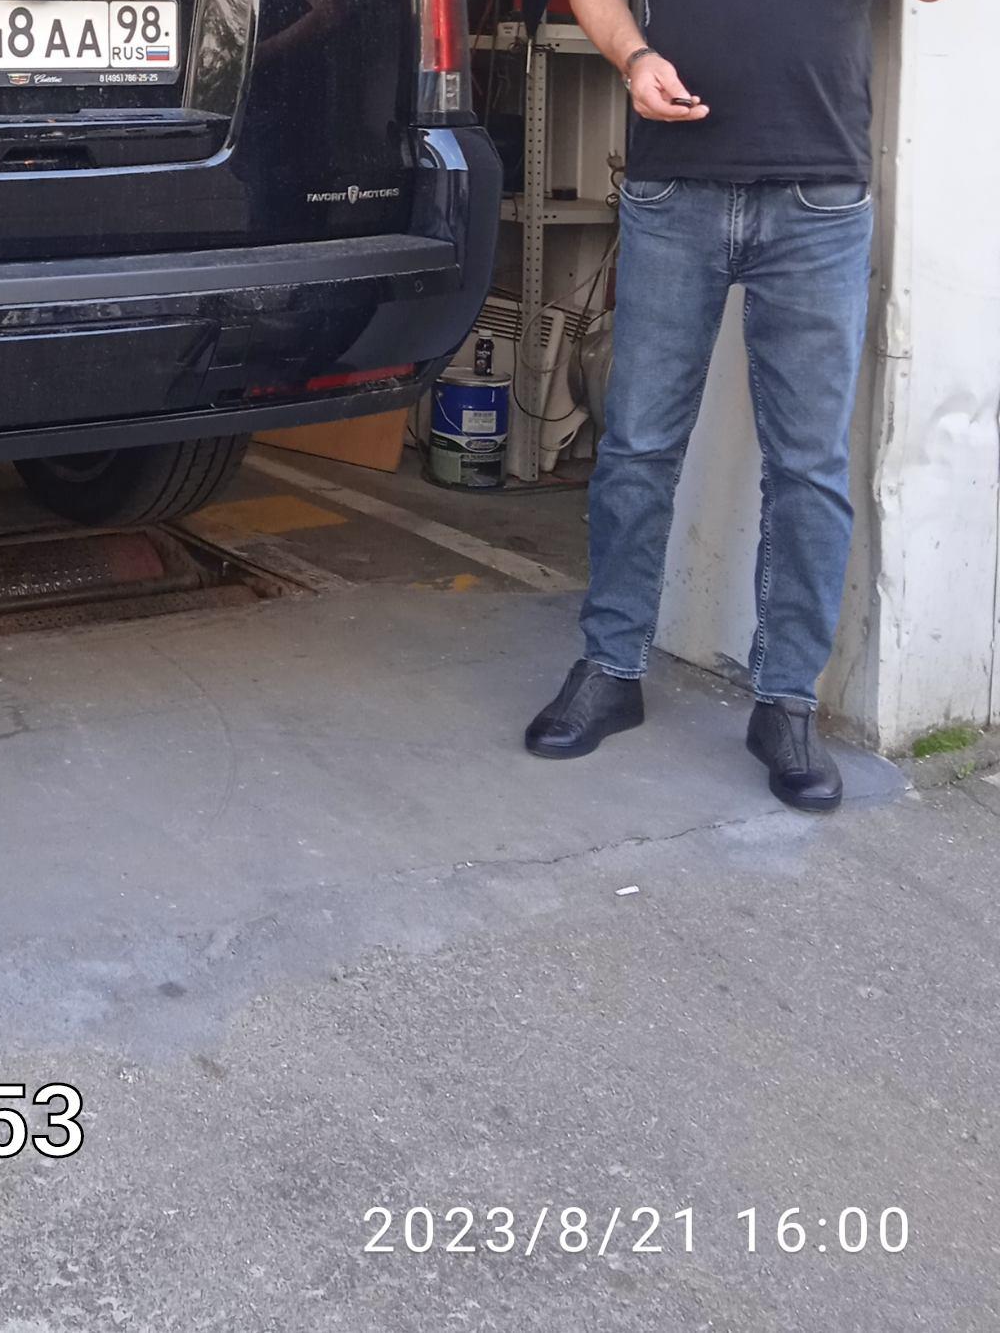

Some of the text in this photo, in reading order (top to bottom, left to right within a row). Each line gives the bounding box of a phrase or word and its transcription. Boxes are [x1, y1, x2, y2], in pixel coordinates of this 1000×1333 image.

[117, 5, 161, 44] 98
[112, 46, 145, 61] RUS
[306, 187, 400, 203] FAVORIT MOTORS
